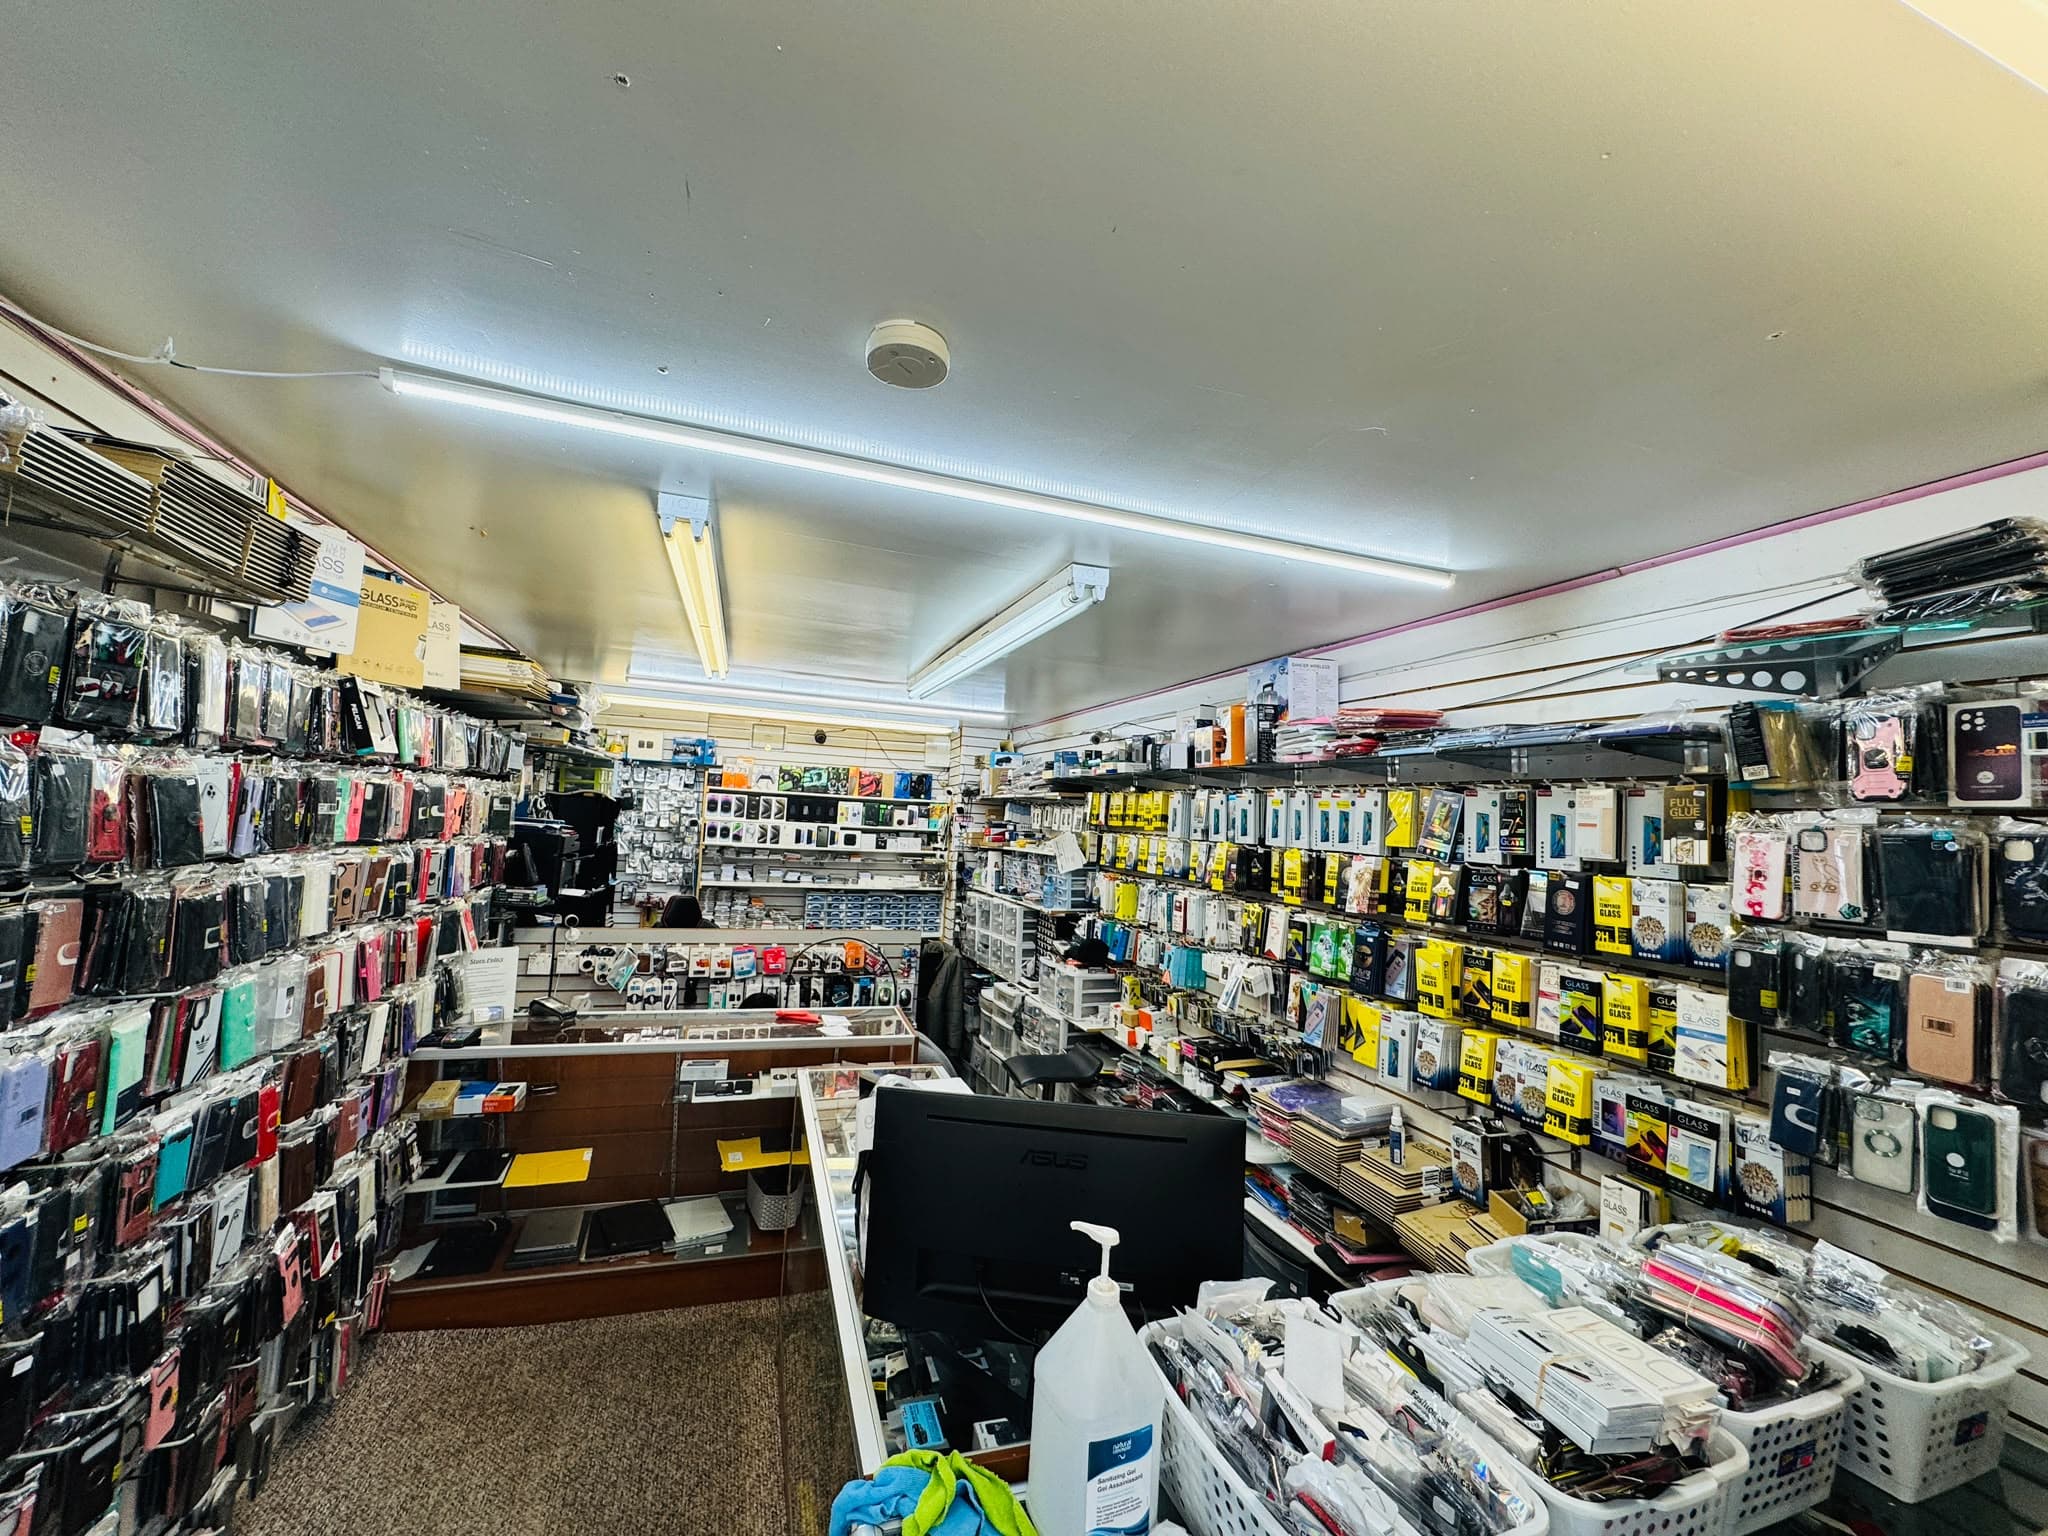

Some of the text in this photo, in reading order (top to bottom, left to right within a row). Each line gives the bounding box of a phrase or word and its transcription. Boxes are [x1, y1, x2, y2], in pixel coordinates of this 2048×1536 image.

[359, 587, 400, 608] GLASS
[350, 703, 364, 730] PELICAN
[1670, 798, 1700, 807] FULL
[1669, 807, 1701, 817] GLUE
[1600, 908, 1622, 919] GLASS
[1595, 930, 1609, 943] 9H
[1467, 957, 1486, 967] GLASS
[1421, 978, 1438, 988] GLASS
[1496, 983, 1516, 993] GLASS
[1565, 979, 1590, 991] GLASS
[1492, 1000, 1504, 1012] 9H
[1608, 1002, 1631, 1011] TEMPERED
[1608, 1008, 1632, 1020] GLASS
[1682, 1012, 1720, 1028] GLASS
[1604, 1030, 1618, 1044] 9H
[1464, 1058, 1482, 1071] GLASS
[1458, 1076, 1470, 1089] 9H
[1552, 1086, 1576, 1099] TEMPERED
[1551, 1093, 1576, 1108] GLASS
[1631, 1099, 1660, 1115] GLASS
[1545, 1112, 1560, 1127] 9H
[1677, 1114, 1709, 1133] GLASS
[1019, 1149, 1089, 1171] ASUS
[1602, 1198, 1628, 1217] GLASS
[1489, 1364, 1516, 1388] SPACE
[1097, 1467, 1137, 1485] Sanitizing Gel
[1096, 1484, 1108, 1493] Gel
